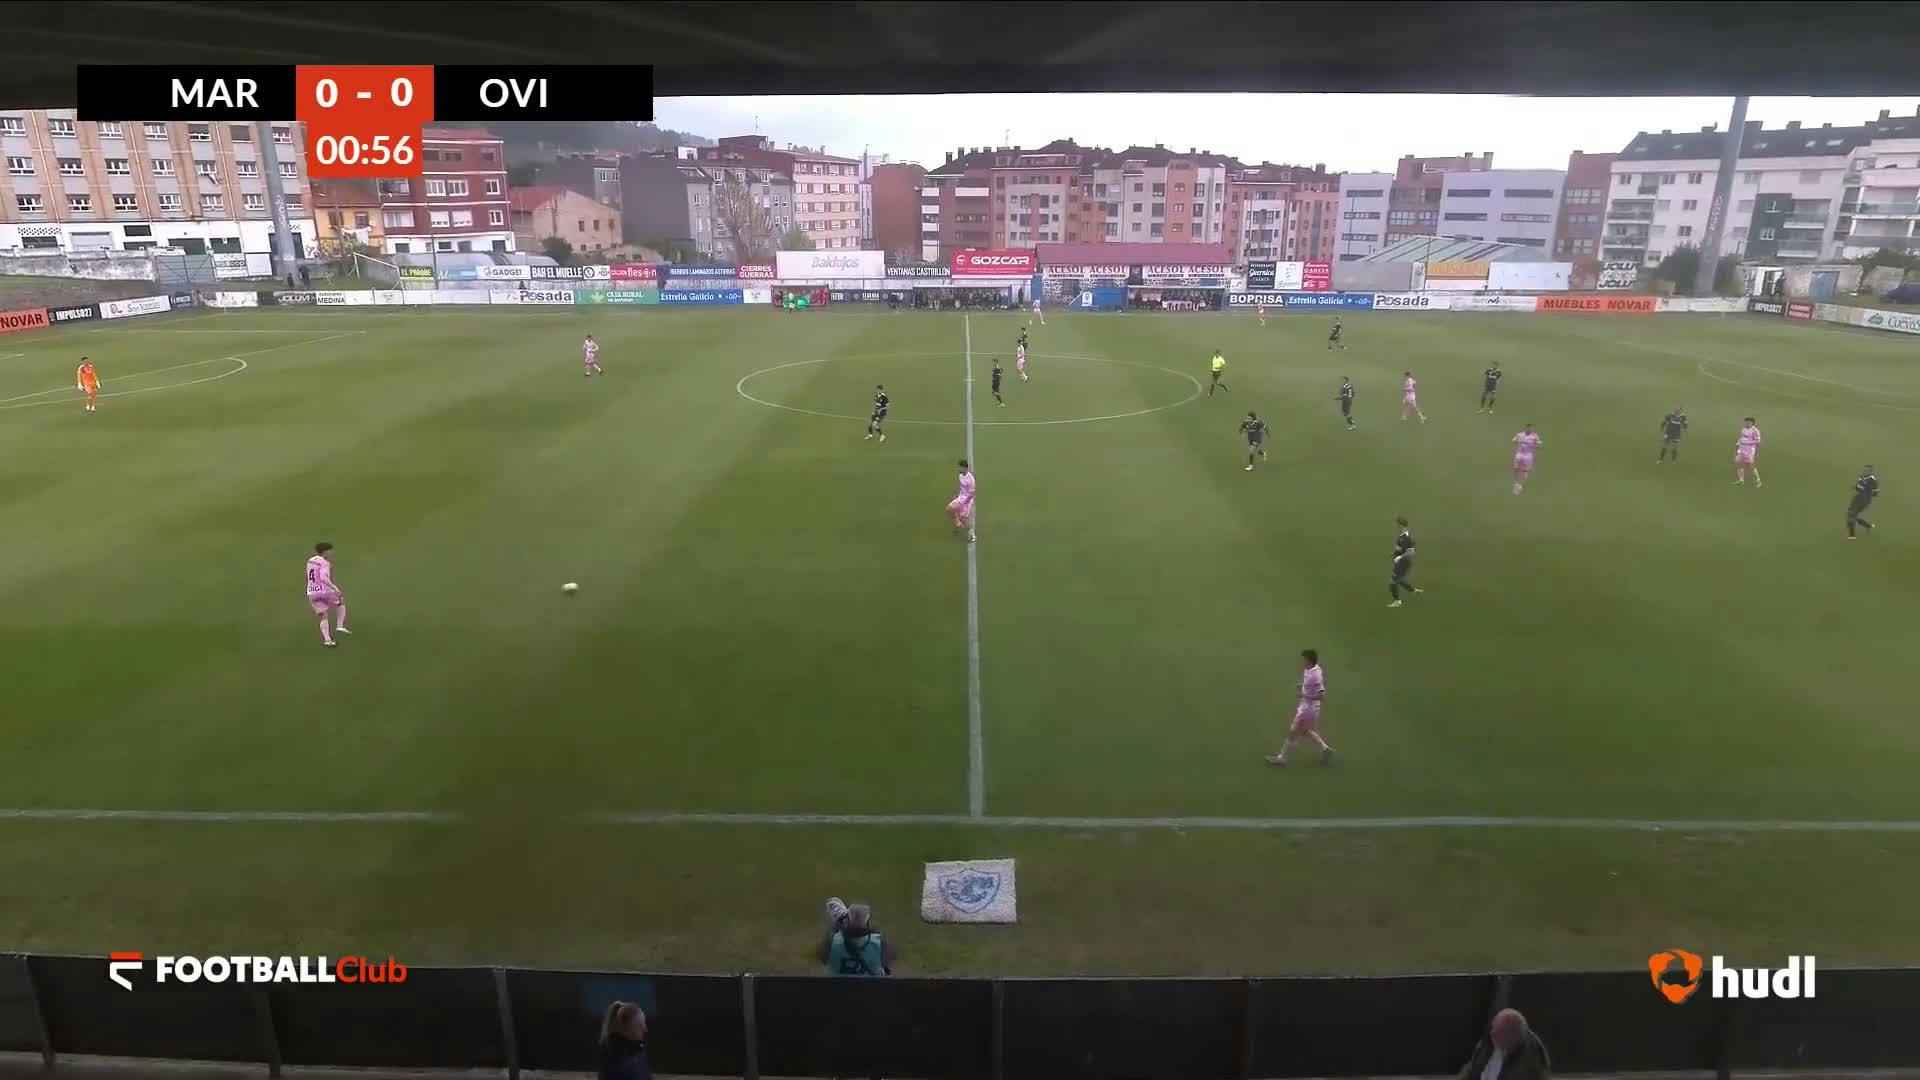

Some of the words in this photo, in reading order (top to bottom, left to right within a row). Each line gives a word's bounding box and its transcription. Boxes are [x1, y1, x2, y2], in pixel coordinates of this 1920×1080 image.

[971, 256, 1029, 265] GOZCAR
[532, 267, 547, 278] BAR
[547, 267, 556, 278] EL
[556, 267, 583, 278] MUELLE
[887, 267, 916, 276] VENTANAS
[520, 290, 572, 301] Posada
[660, 292, 688, 301] Estrella
[689, 292, 714, 301] Galicia
[1288, 296, 1316, 305] Estrella
[1318, 296, 1344, 305] Galicia
[1376, 295, 1429, 306] Posada
[1543, 299, 1601, 309] MUEBLES
[1607, 300, 1650, 310] NOVAR
[1, 313, 44, 329] NOVAR
[308, 568, 316, 583] 4
